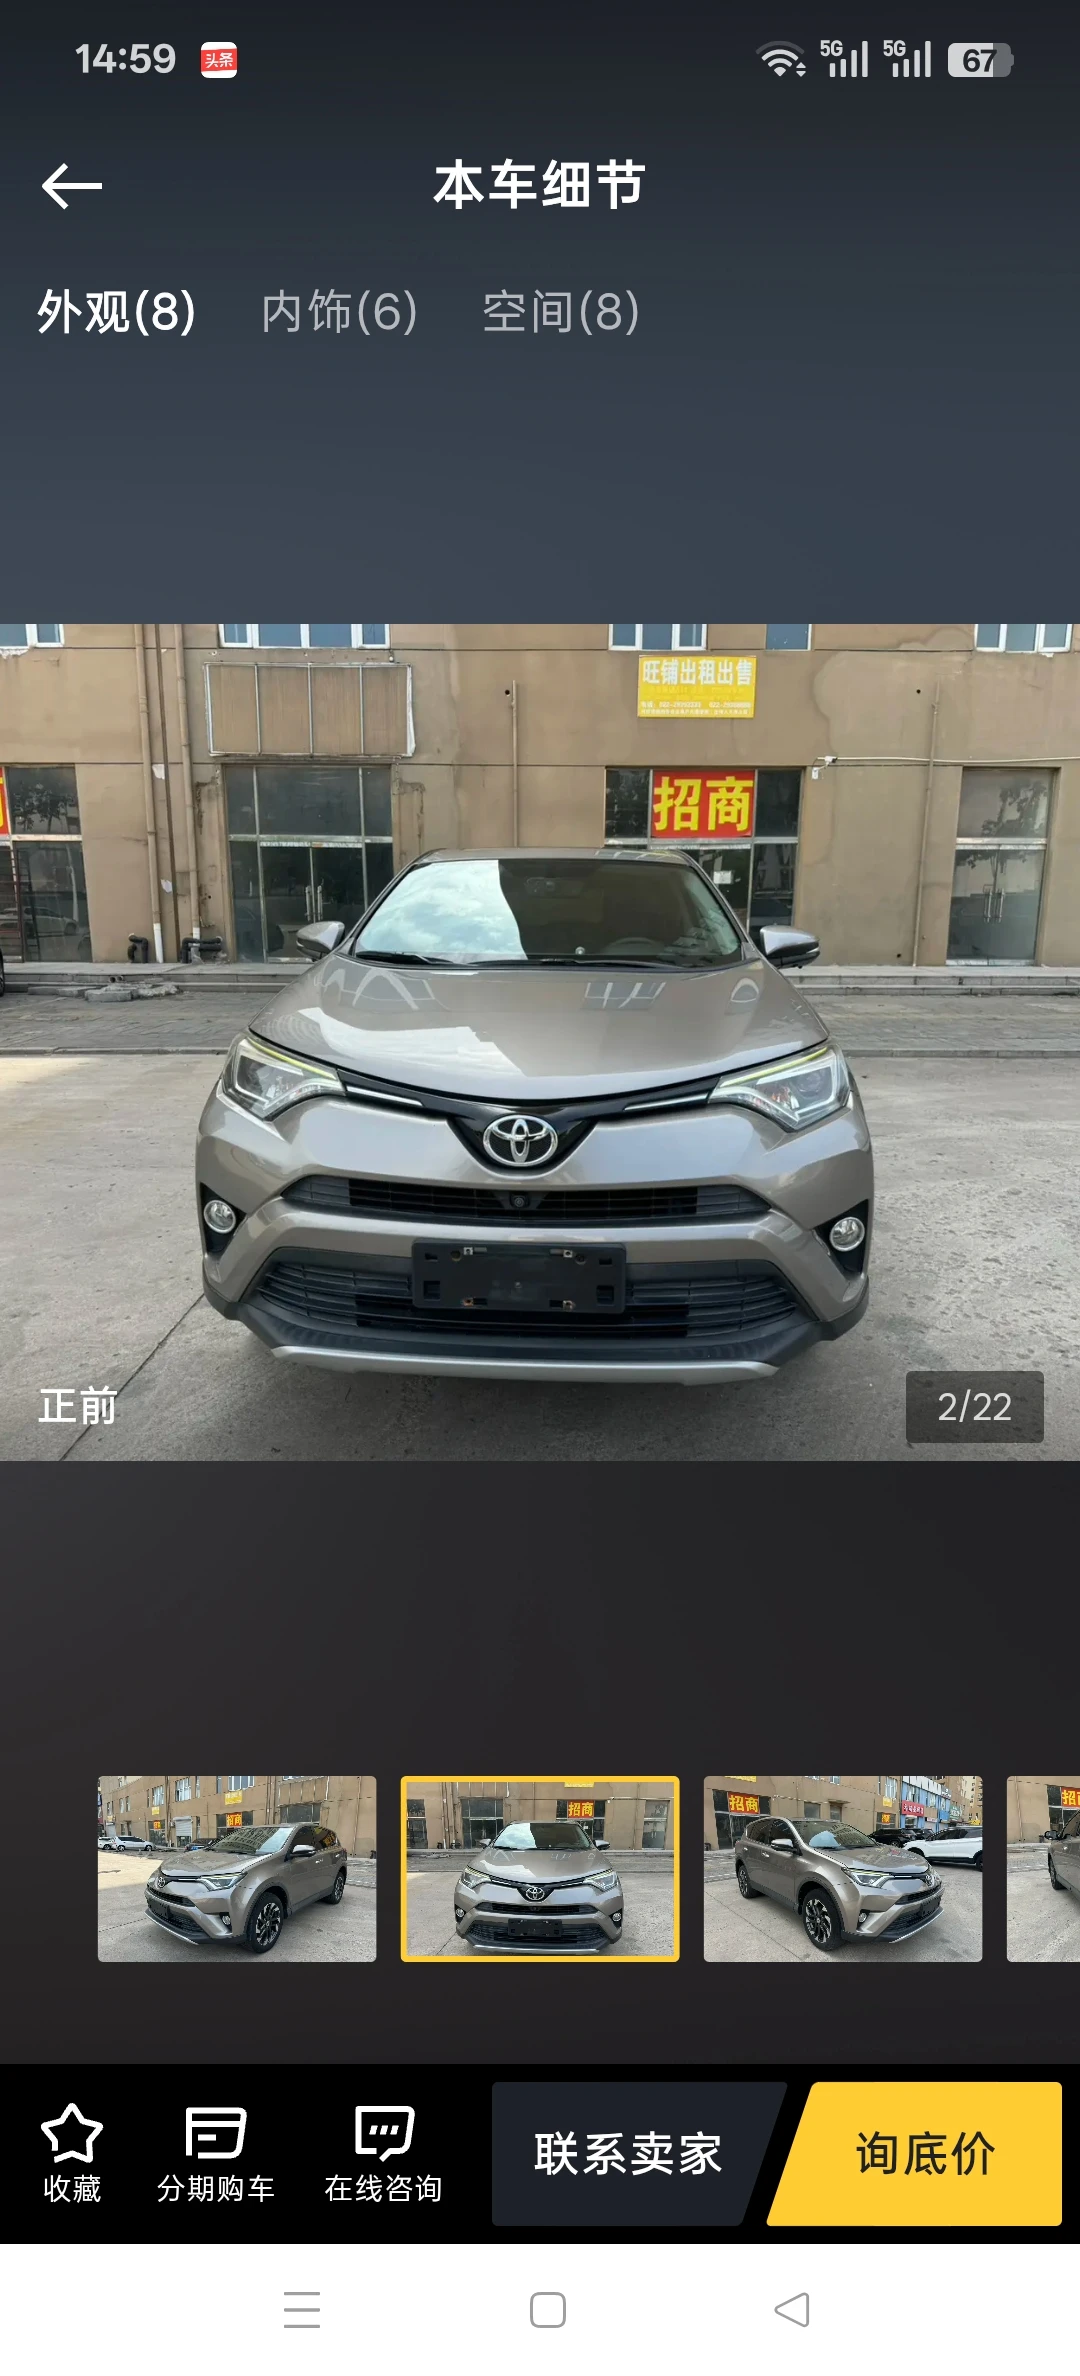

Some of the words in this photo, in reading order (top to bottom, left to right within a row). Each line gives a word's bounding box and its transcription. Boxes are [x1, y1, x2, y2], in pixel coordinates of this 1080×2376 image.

[76, 43, 176, 74] 14:59
[204, 52, 234, 69] 头条
[819, 39, 844, 57] 5G
[882, 39, 907, 57] 5G
[962, 48, 998, 73] 67
[432, 157, 647, 210] 本车细节
[36, 288, 196, 337] 外观(8)
[262, 288, 418, 337] 内饰(6)
[482, 288, 640, 337] 空间(8)
[642, 658, 753, 686] 旺铺出租出售
[653, 775, 754, 832] 招商
[568, 1801, 594, 1817] 招商
[728, 1794, 759, 1813] 招商
[533, 2130, 723, 2176] 联系卖家
[855, 2130, 997, 2176] 询底价
[43, 2173, 102, 2204] 收藏
[156, 2173, 275, 2204] 分期购车
[324, 2173, 443, 2204] 在线咨询
